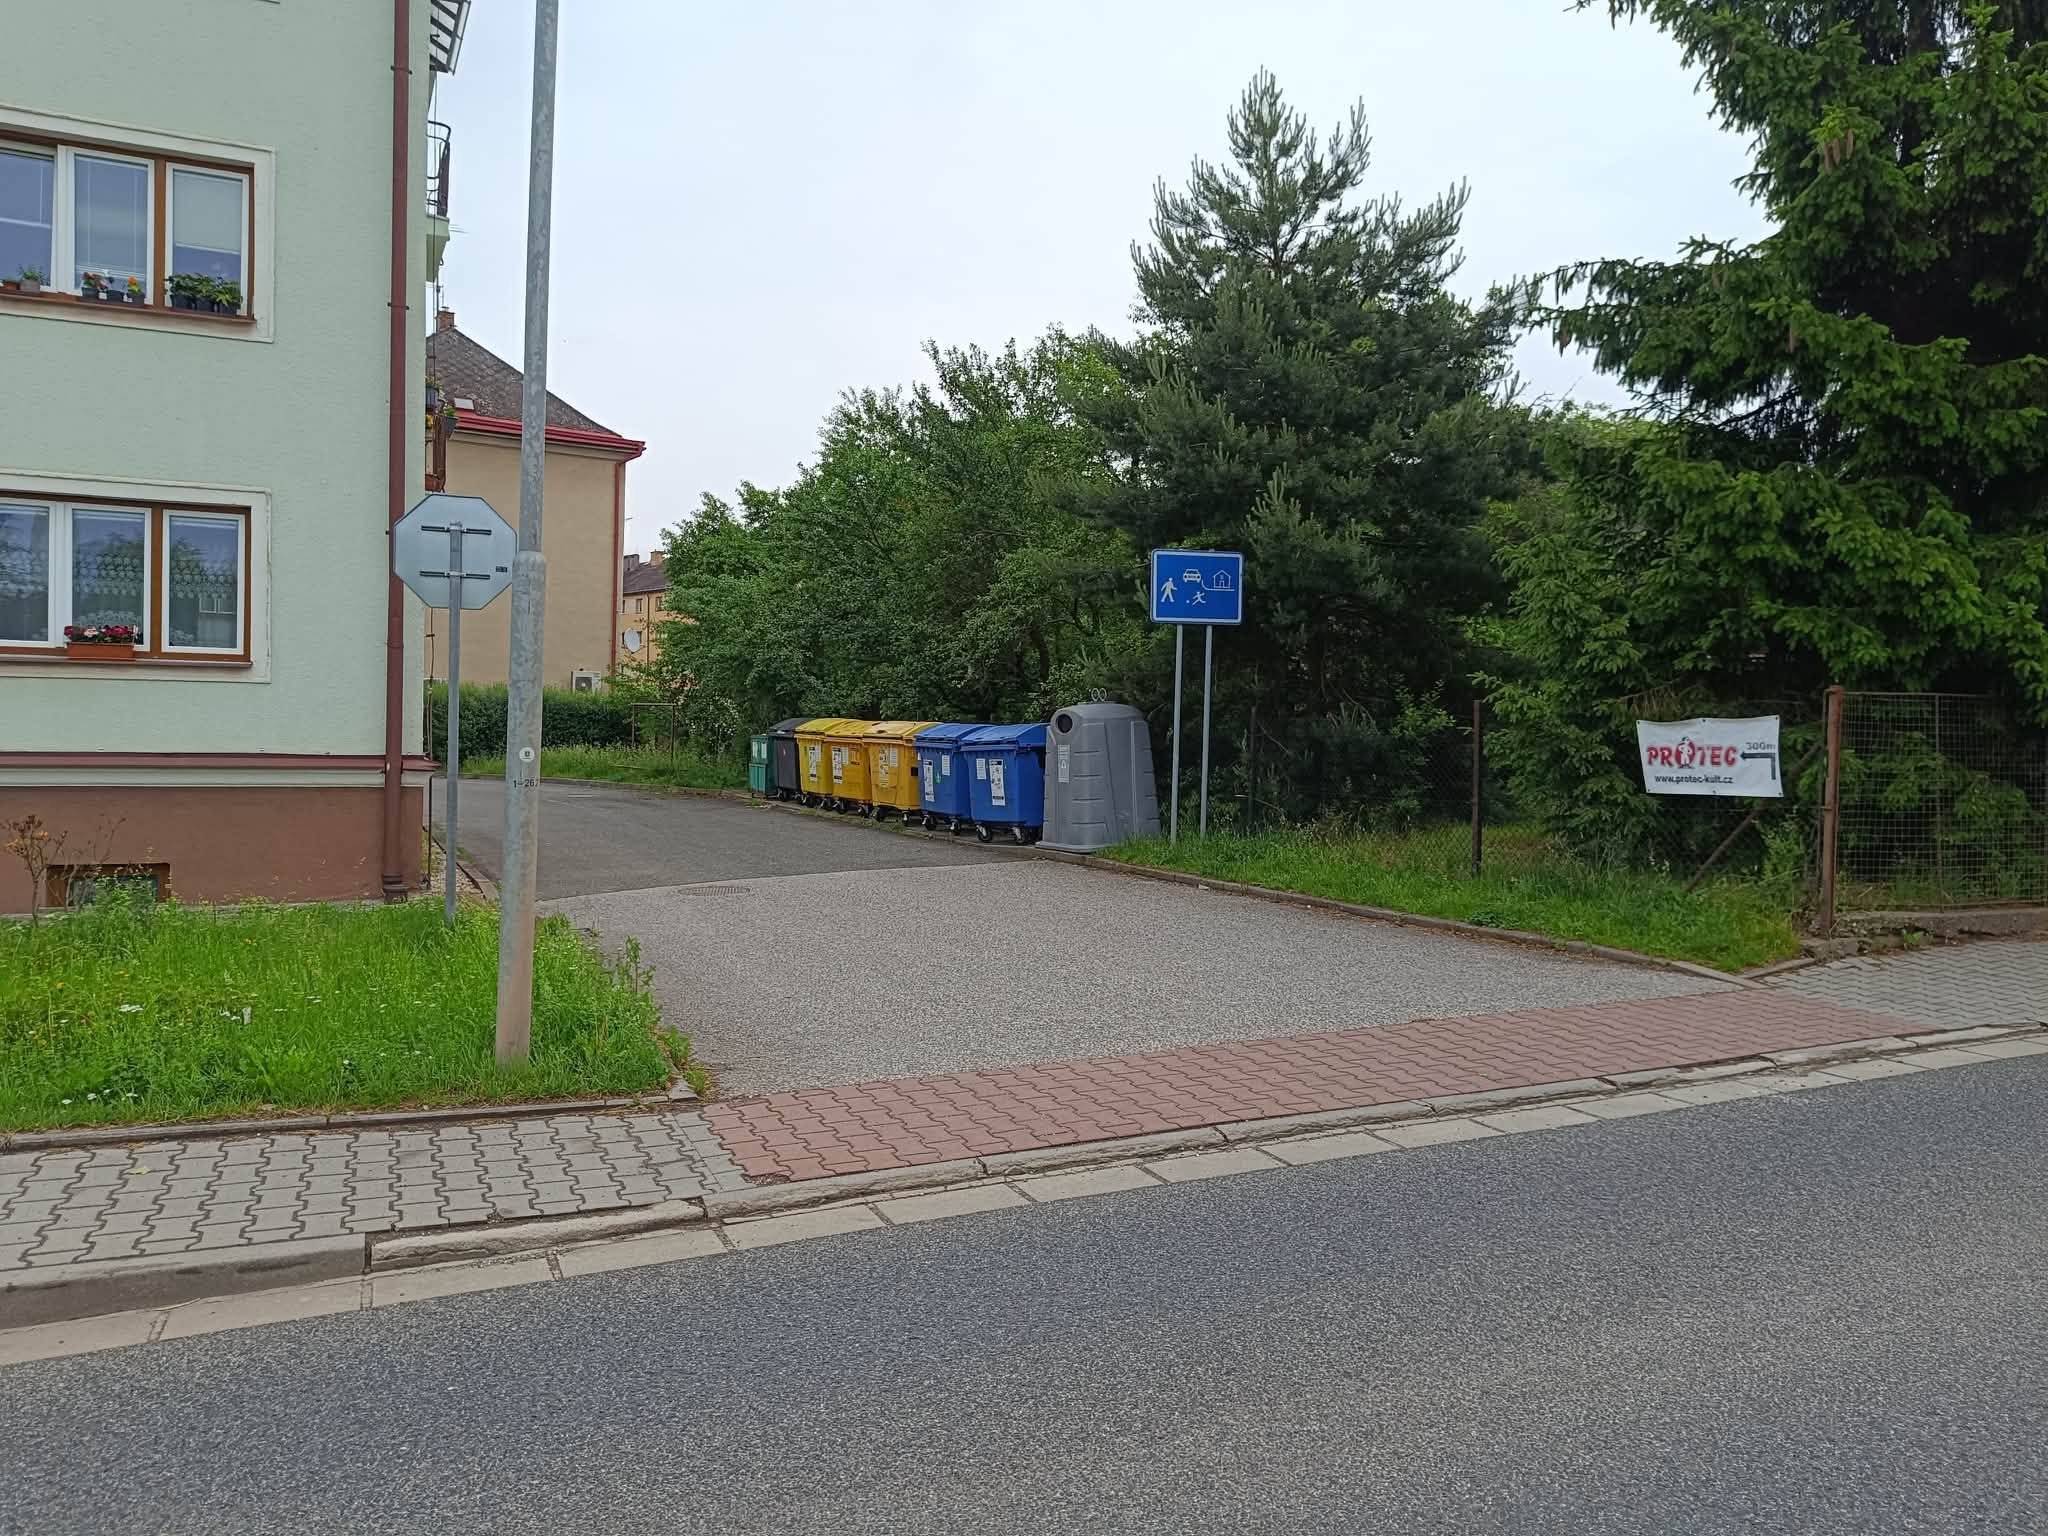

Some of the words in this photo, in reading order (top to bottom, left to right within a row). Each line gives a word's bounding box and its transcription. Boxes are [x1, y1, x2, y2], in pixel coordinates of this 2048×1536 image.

[1745, 741, 1776, 750] 300m
[1646, 741, 1738, 767] PROTEC
[1654, 774, 1734, 784] www.protec-kult.cz
